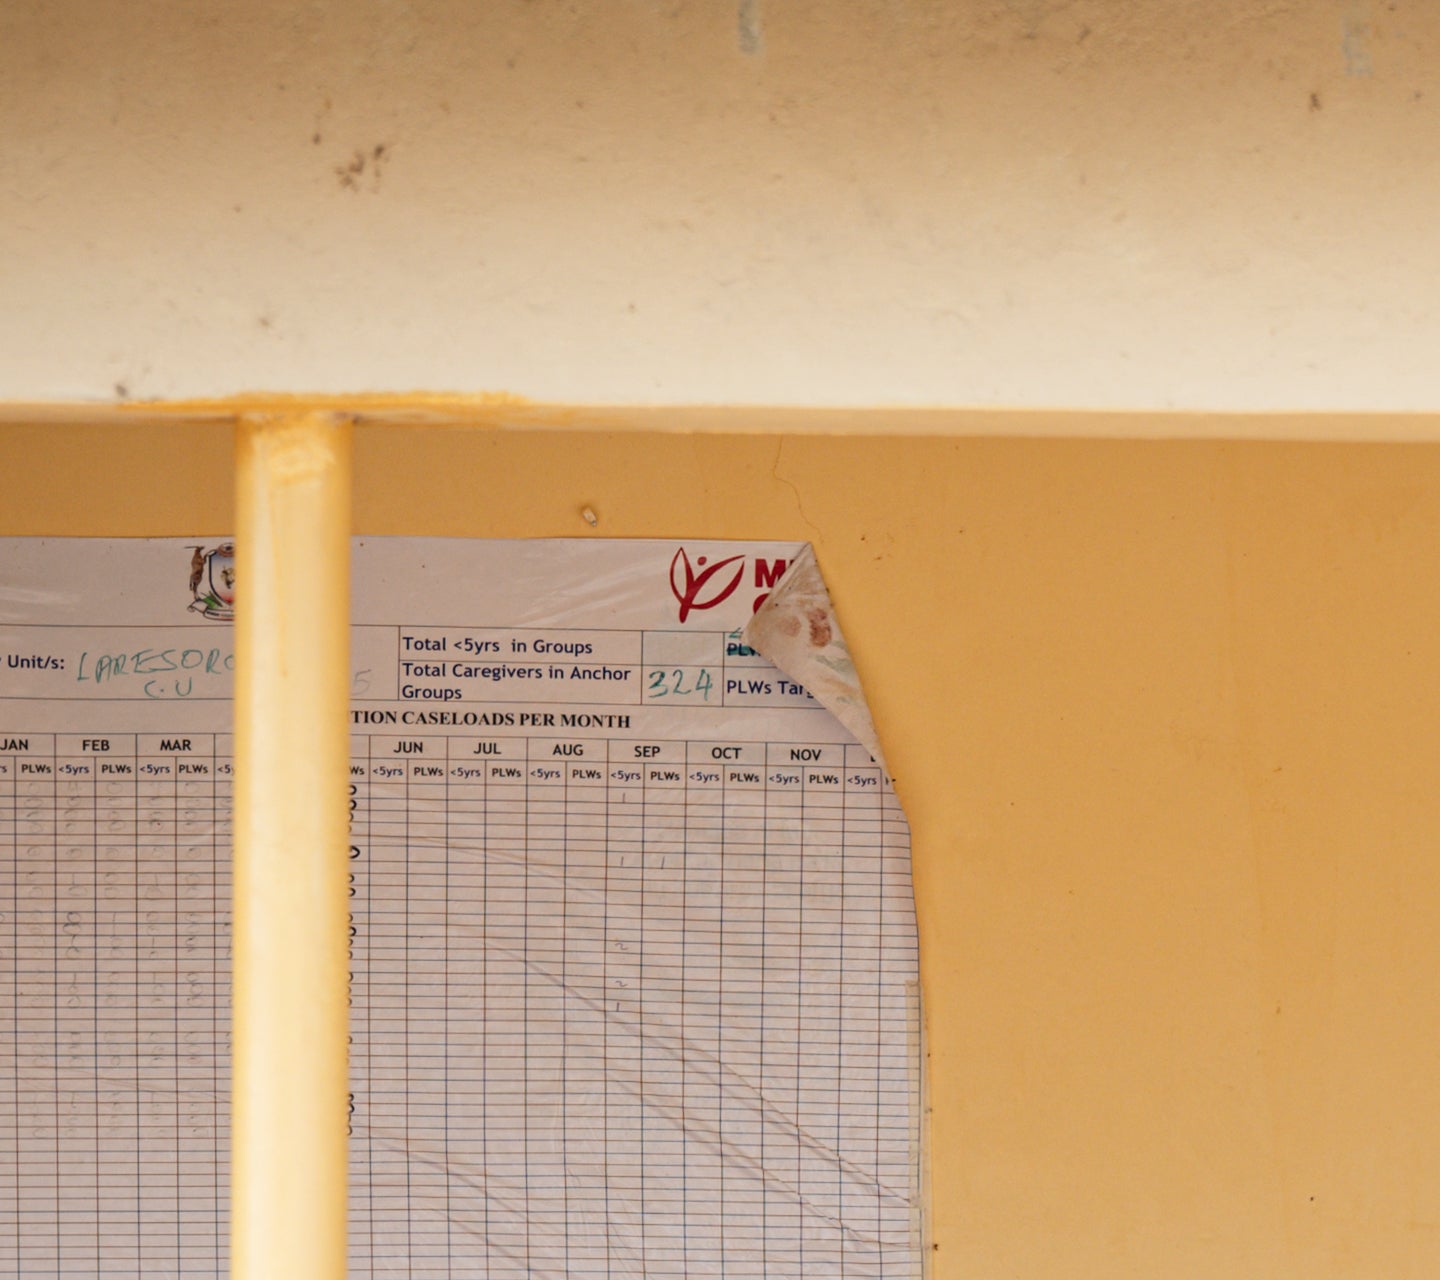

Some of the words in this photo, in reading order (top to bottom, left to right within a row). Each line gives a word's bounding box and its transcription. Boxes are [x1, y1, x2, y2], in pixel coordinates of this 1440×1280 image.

[402, 637, 447, 651] Total
[454, 639, 500, 655] <5yrs
[511, 639, 527, 653] in
[533, 640, 593, 657] Groups
[8, 654, 65, 670] Unit/s:
[402, 663, 447, 677] Total
[452, 664, 542, 681] Caregivers
[549, 665, 564, 679] in
[570, 666, 631, 680] Anchor
[648, 669, 713, 702] 324
[727, 680, 772, 694] PLWs
[402, 685, 462, 701] Groups
[350, 710, 397, 725] TION
[402, 711, 515, 726] CASELOADS
[520, 713, 555, 727] PER
[560, 714, 631, 729] MONTH
[0, 738, 28, 751] JAN
[82, 739, 110, 751] FEB
[160, 739, 191, 751] MAR
[393, 742, 423, 754] JUN
[473, 743, 501, 755] JUL
[552, 744, 584, 756] AUG
[634, 746, 661, 758] SEP
[711, 748, 742, 759] OCT
[790, 749, 822, 761] NOV
[21, 764, 52, 774] PLWs
[414, 767, 443, 777] PLWs
[650, 771, 680, 781] PLWs
